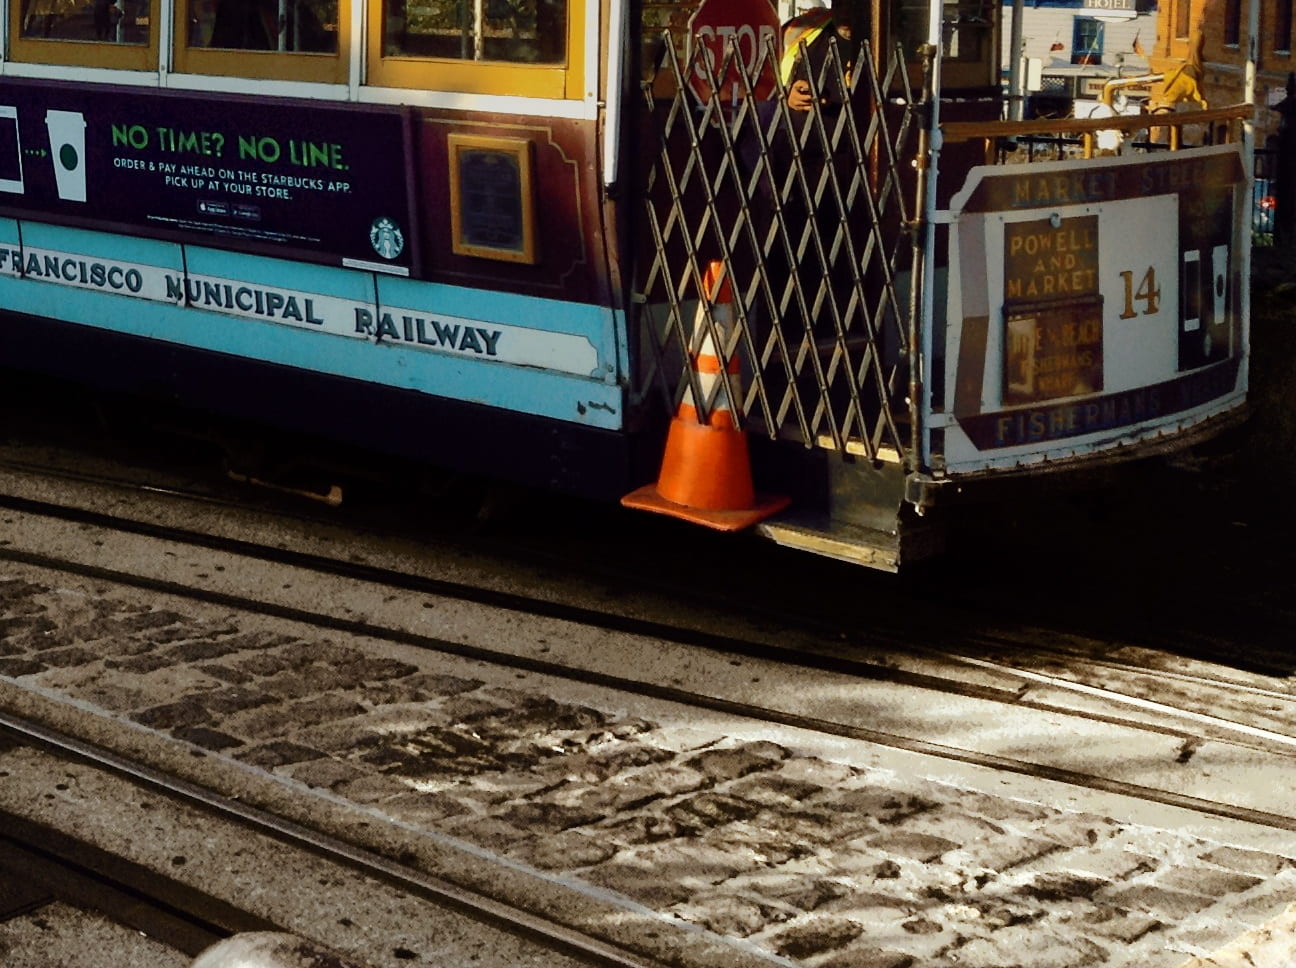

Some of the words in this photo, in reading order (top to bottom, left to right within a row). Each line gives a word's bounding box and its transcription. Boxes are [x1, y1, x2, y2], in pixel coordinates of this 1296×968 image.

[694, 23, 776, 81] STOP
[111, 123, 149, 150] NO
[156, 127, 225, 158] TIME?
[238, 134, 281, 163] NO
[289, 139, 350, 171] LINE.
[113, 157, 146, 170] ORDER
[148, 162, 156, 172] &
[158, 162, 176, 174] PAY
[180, 165, 215, 178] AHEAD
[218, 169, 235, 180] ON
[237, 171, 258, 183] THE
[261, 173, 324, 191] STARBUCKS
[327, 181, 353, 194] APP.
[165, 175, 189, 188] PICK
[191, 178, 205, 189] UP
[207, 180, 220, 191] AT
[223, 182, 253, 196] YOUR
[255, 185, 294, 200] STORE.
[1014, 173, 1118, 204] MARKET
[1010, 230, 1095, 257] POWELL
[1034, 254, 1077, 272] AND
[1007, 269, 1096, 297] MARKET
[1118, 265, 1162, 320] 14
[165, 275, 324, 326] MUNICIPAL
[354, 306, 503, 356] RAILWAY
[995, 391, 1162, 445] FISHERMANS
